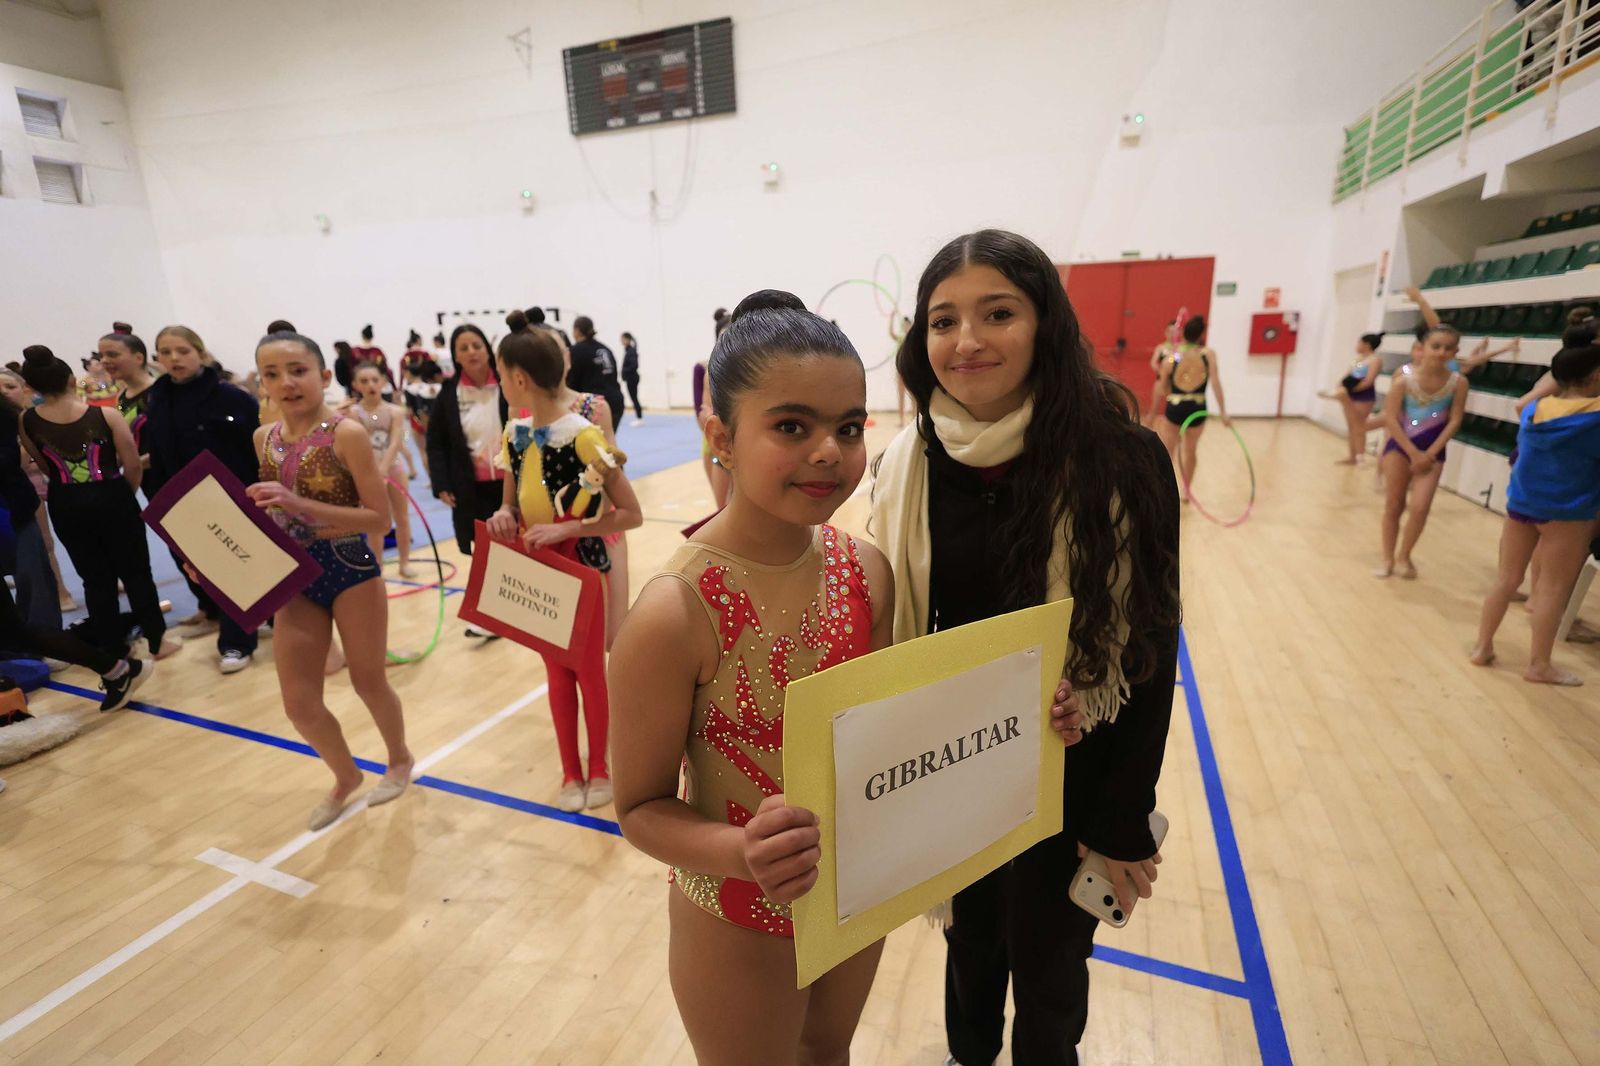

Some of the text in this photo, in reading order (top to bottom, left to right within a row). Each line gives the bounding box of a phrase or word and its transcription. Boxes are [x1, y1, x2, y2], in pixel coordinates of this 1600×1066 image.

[207, 523, 251, 563] JEREZ
[498, 586, 558, 620] RIOTINTO
[501, 573, 561, 608] MINAS DE
[864, 715, 1021, 801] GIBRALTAR
